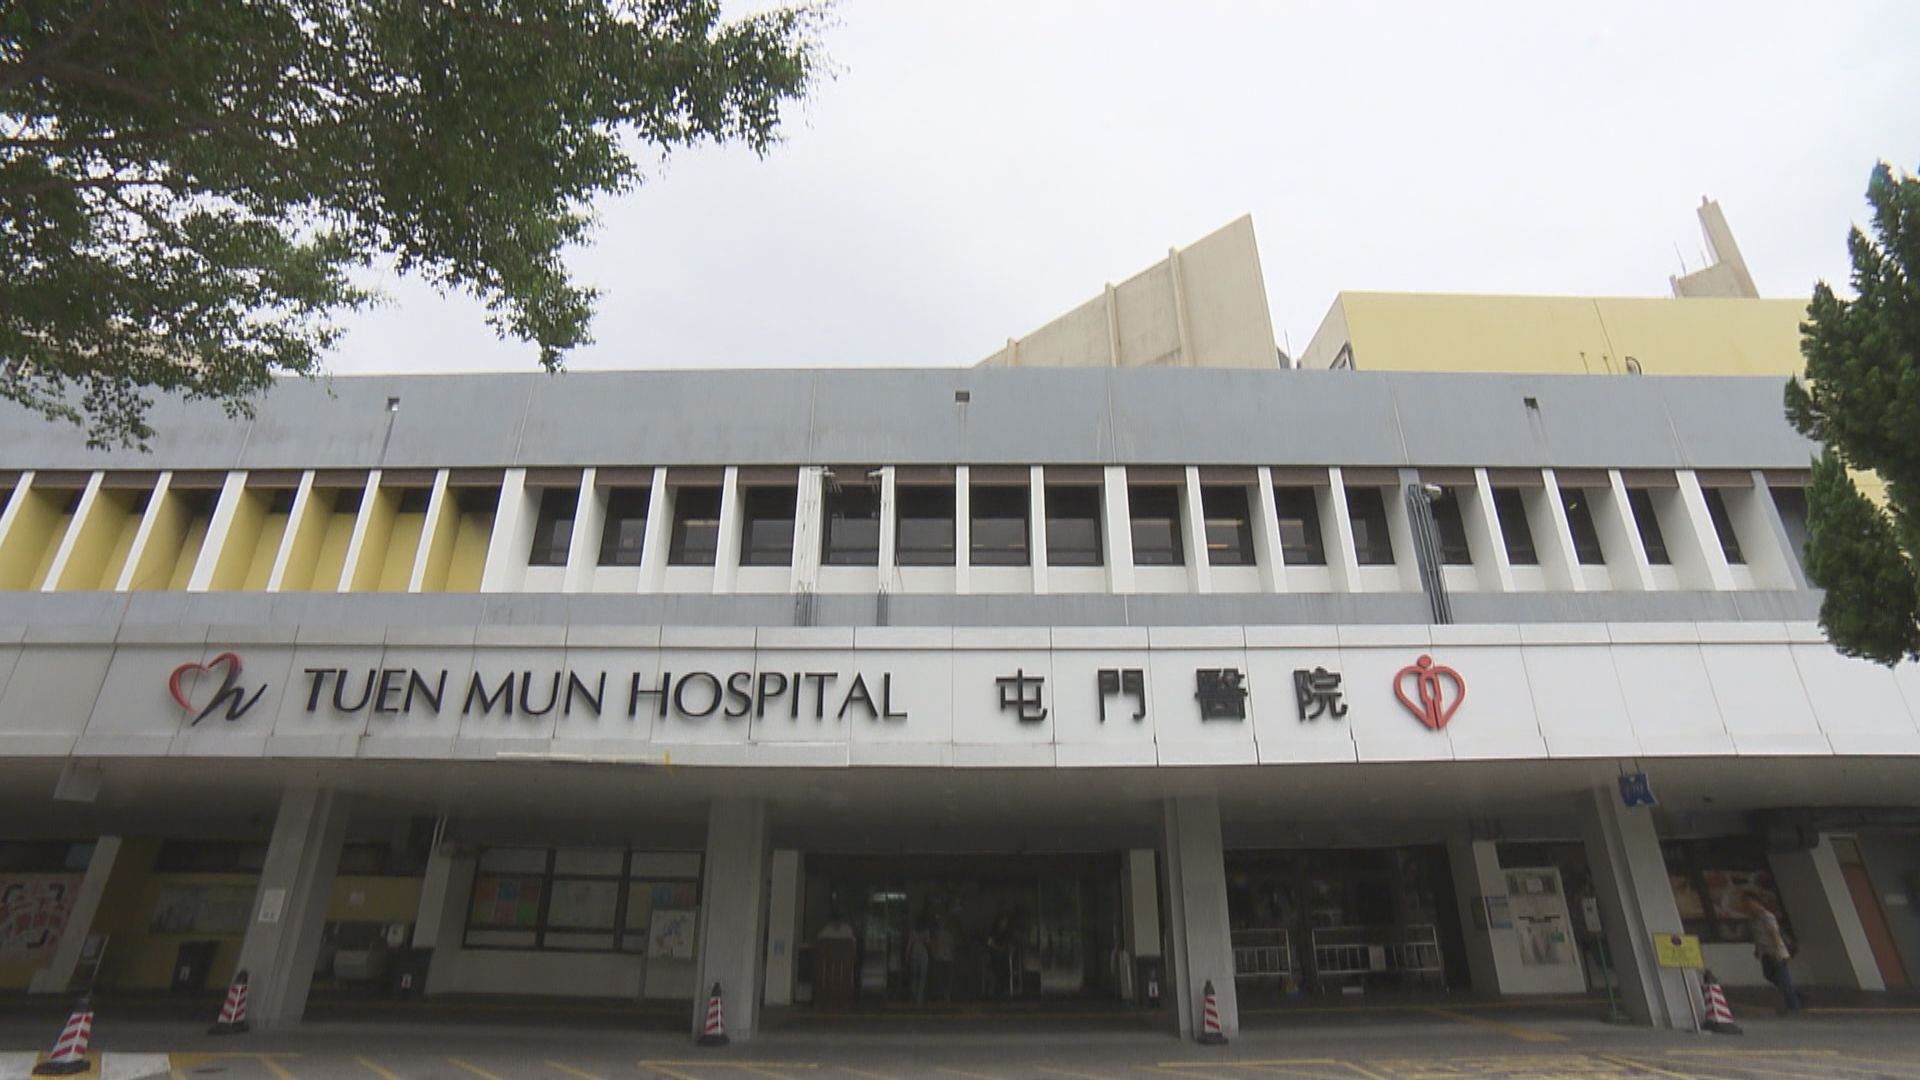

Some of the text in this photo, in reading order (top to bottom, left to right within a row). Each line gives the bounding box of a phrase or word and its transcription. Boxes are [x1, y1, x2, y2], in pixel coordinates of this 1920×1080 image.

[304, 668, 907, 720] TUEN MUN HOSPITAL
[995, 667, 1348, 723] 屯門醫院
